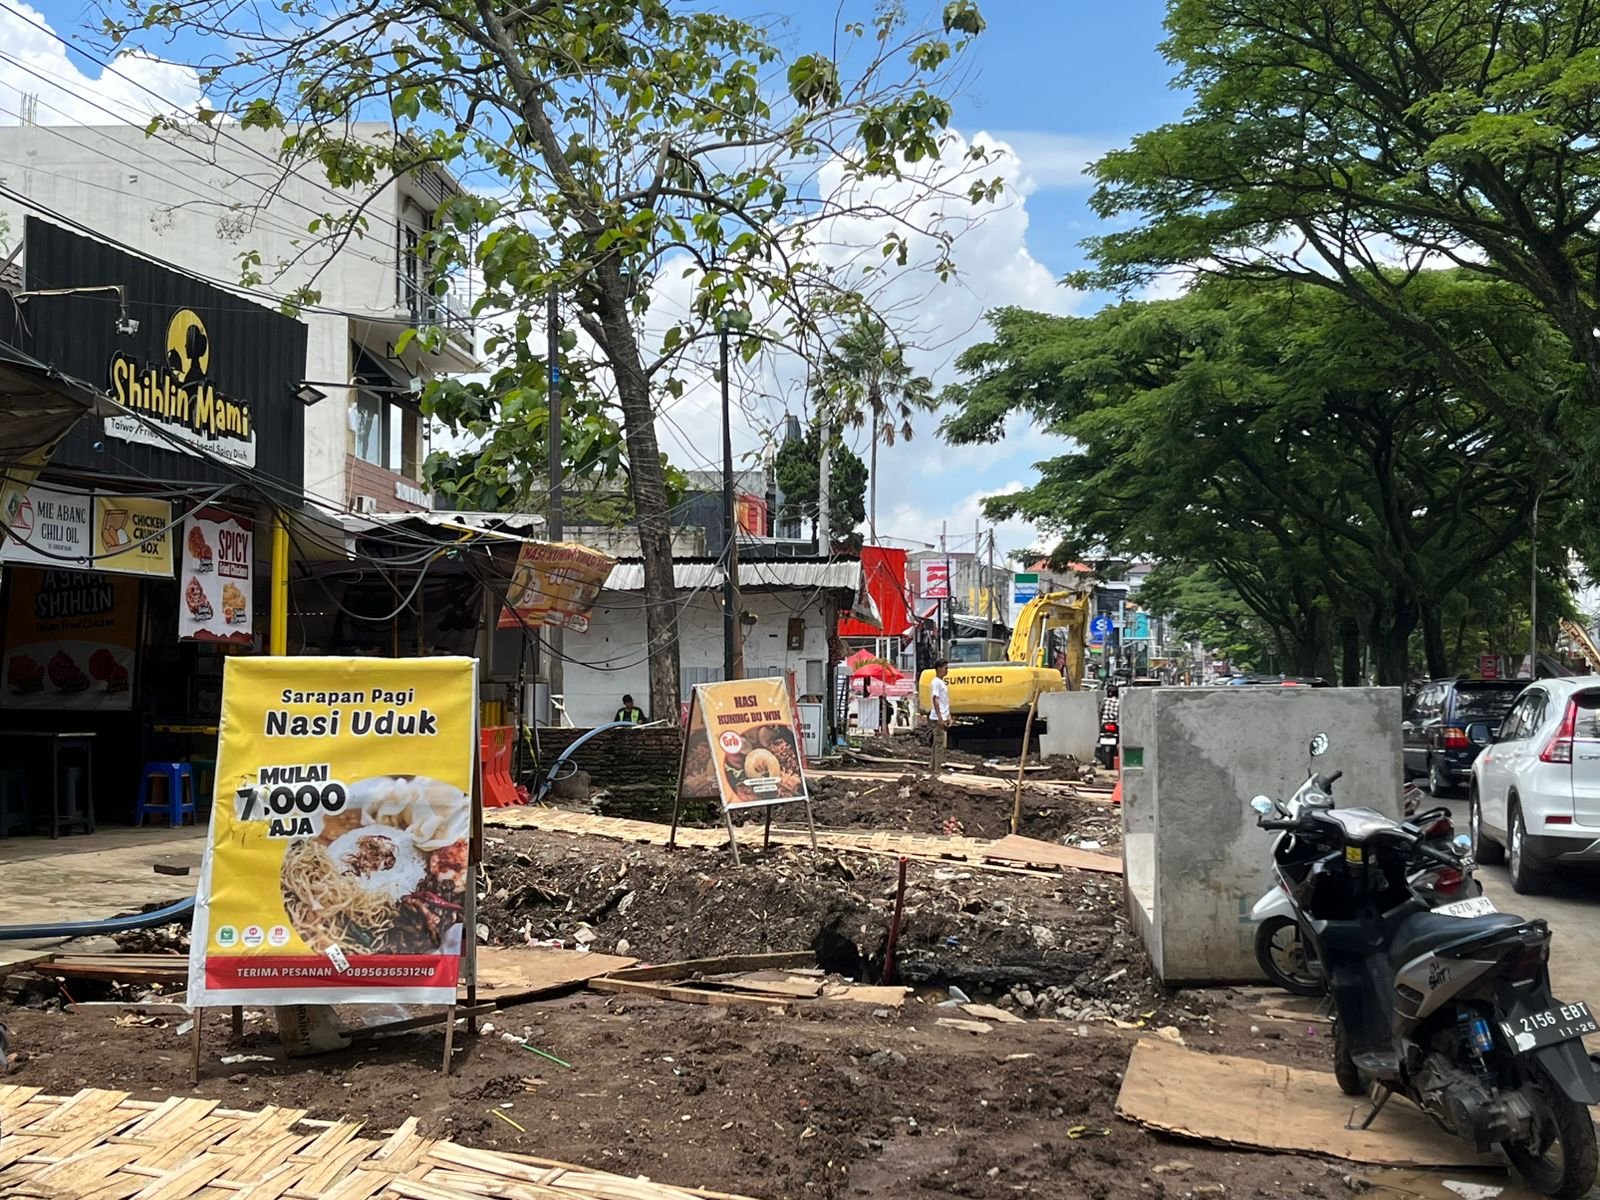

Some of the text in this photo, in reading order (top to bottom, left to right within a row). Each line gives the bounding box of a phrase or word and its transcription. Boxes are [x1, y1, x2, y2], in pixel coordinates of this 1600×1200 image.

[112, 358, 249, 437] Shihlin Mami
[37, 501, 54, 519] MIE
[132, 514, 166, 528] CHICKEN
[41, 523, 80, 544] CHILI OIL
[140, 543, 159, 555] BOX
[218, 528, 249, 563] SPICY
[37, 585, 113, 617] SHIHLIN
[943, 675, 1003, 685] SUMITOMO
[281, 688, 415, 706] Sarapan Pagi
[734, 695, 758, 708] NASI
[265, 709, 437, 736] Nasi Uduk
[717, 710, 781, 725] KUNING BU WIN
[260, 765, 328, 784] MULAI
[235, 784, 346, 821] 7.000
[269, 817, 315, 837] AJA
[1447, 902, 1473, 916] 6270
[237, 966, 435, 977] TERIMA PESANAN 0895636531248
[1501, 1002, 1588, 1038] N 2156 EBT
